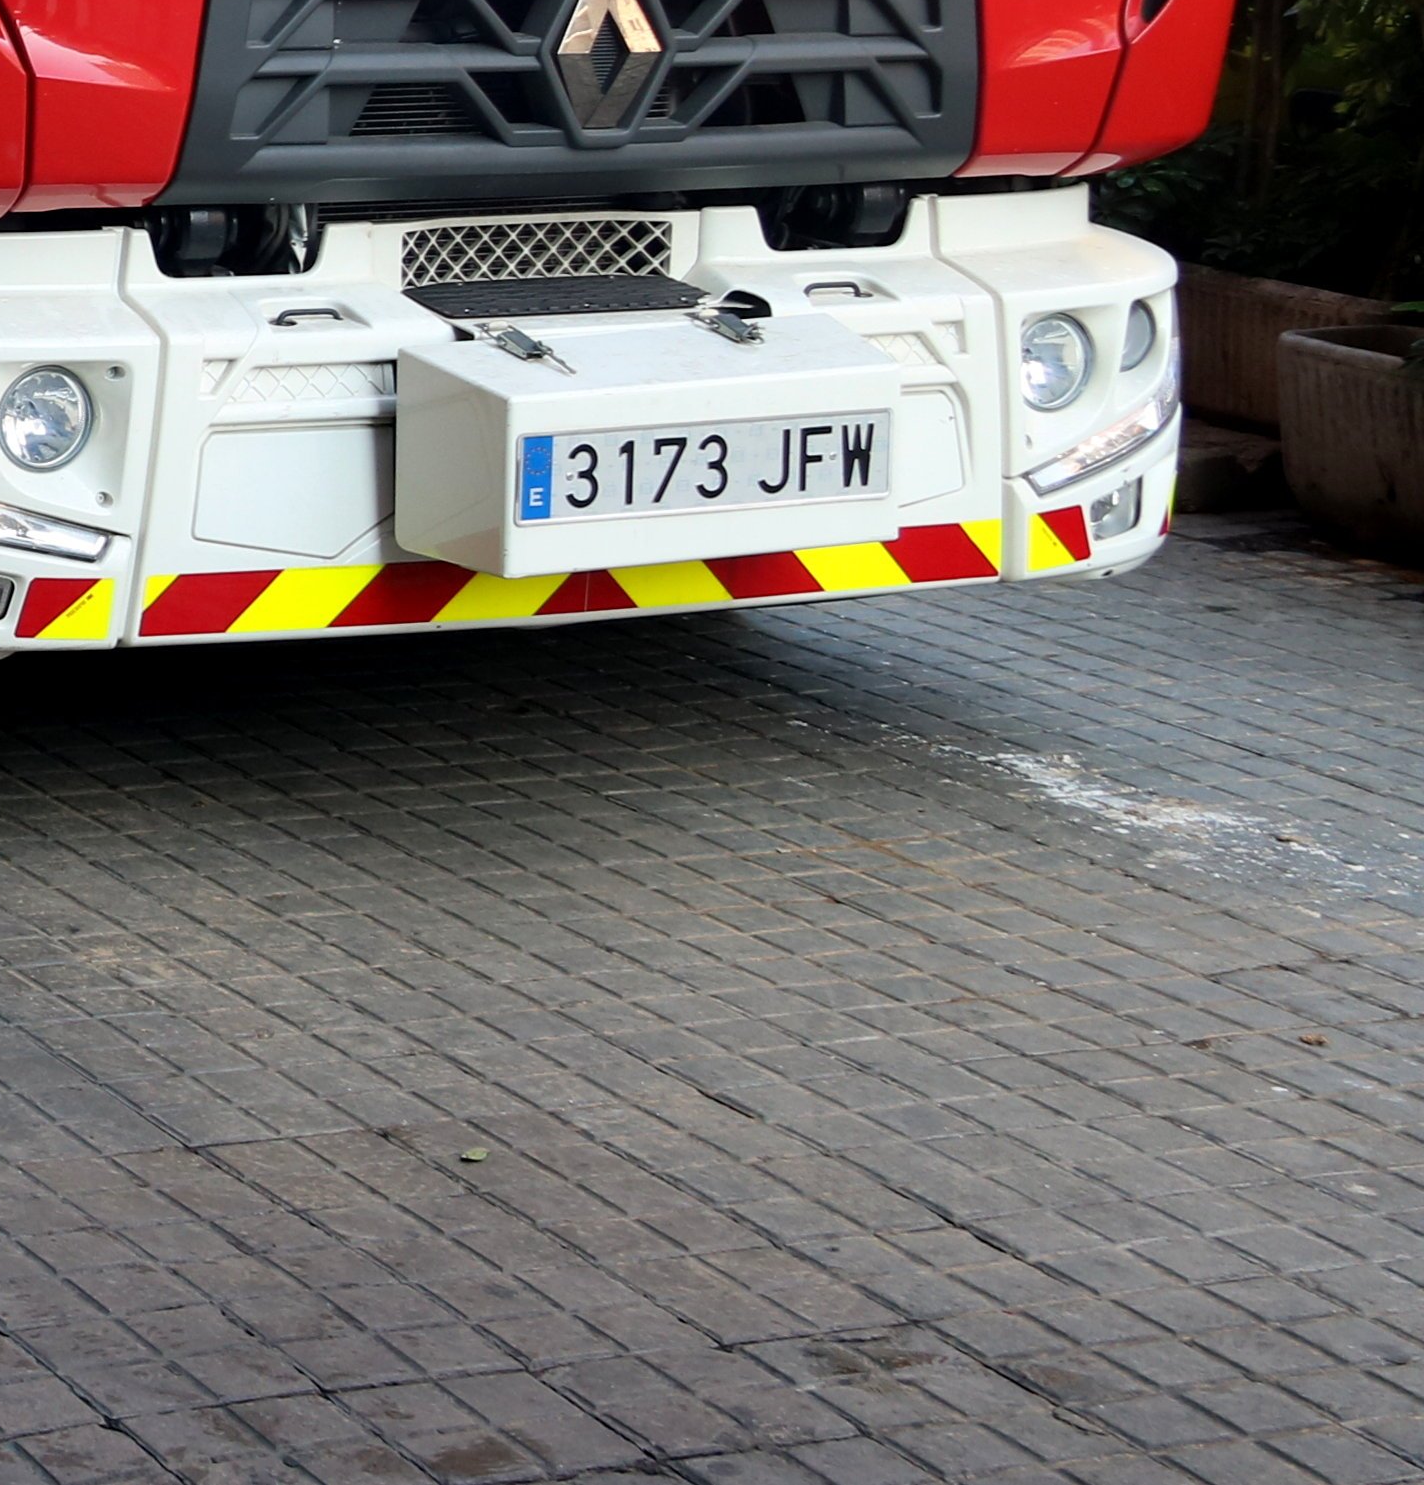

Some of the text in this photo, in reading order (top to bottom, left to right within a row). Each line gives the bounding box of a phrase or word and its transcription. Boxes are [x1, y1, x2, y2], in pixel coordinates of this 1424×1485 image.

[529, 422, 875, 509] E 3173 JFW
